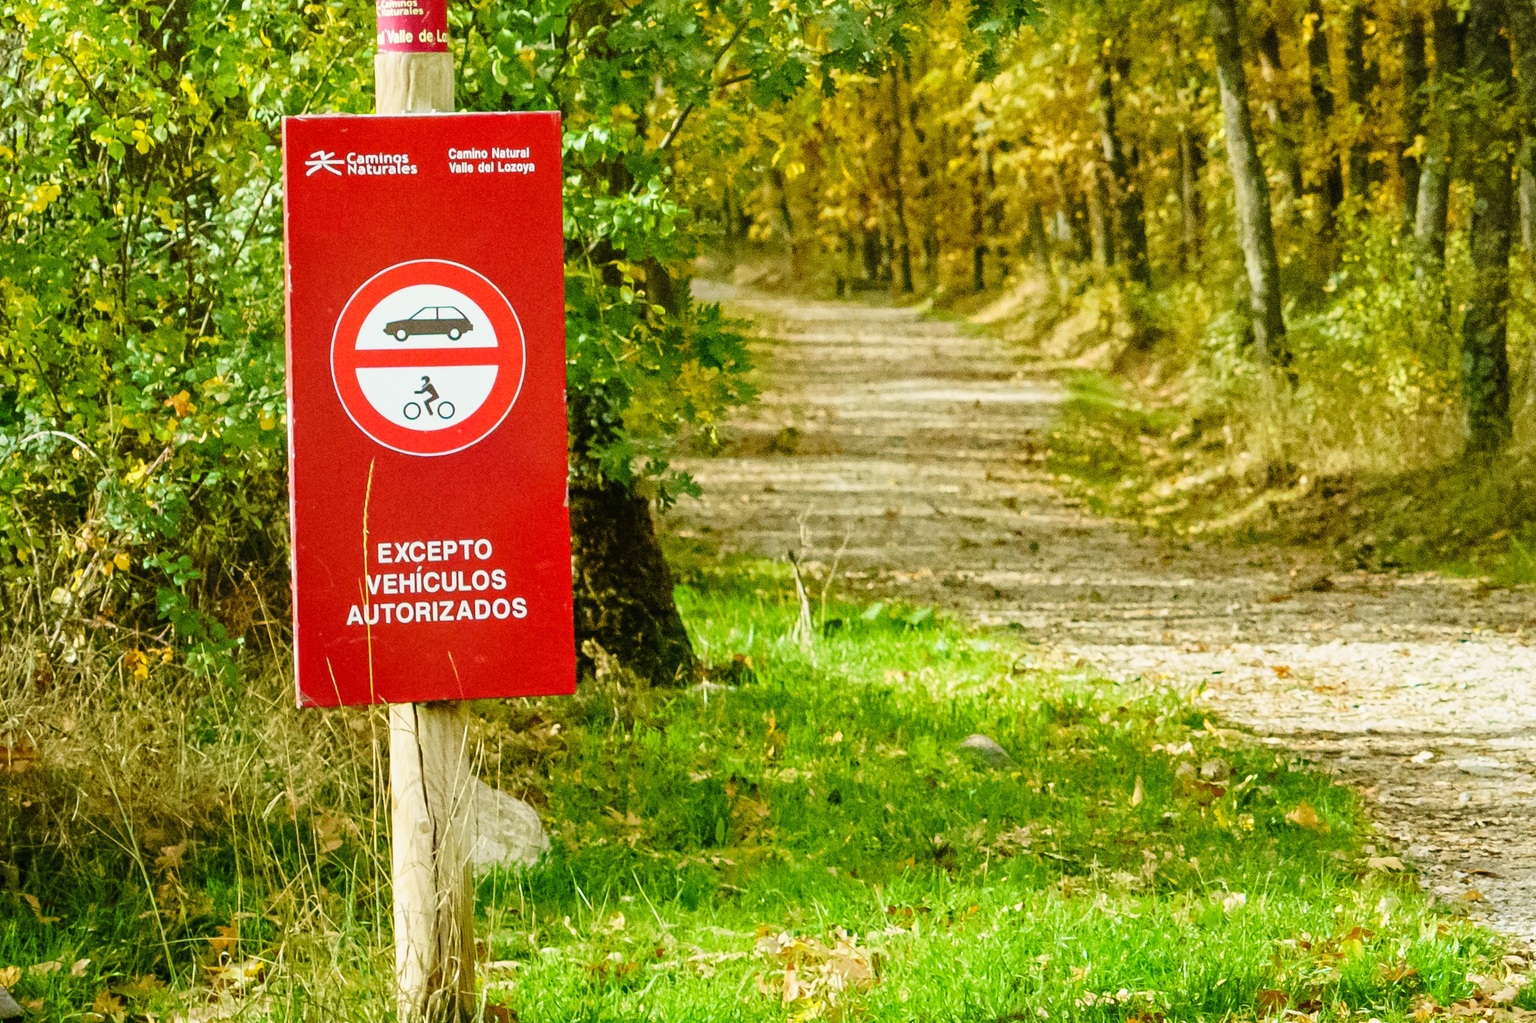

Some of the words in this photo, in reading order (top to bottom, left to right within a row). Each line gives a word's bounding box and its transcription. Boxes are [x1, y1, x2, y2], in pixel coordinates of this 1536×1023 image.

[381, 7, 424, 17] Naturales
[387, 28, 413, 44] Valle
[418, 28, 434, 43] de
[346, 151, 409, 165] Caminos
[448, 147, 489, 160] Camino
[491, 146, 530, 159] Natural
[347, 161, 418, 176] Naturales
[448, 161, 474, 174] Valle
[477, 160, 495, 174] del
[497, 160, 536, 175] Lozoya
[377, 538, 493, 564] EXCEPTO
[366, 565, 507, 595] VEHÍCULOS
[346, 597, 528, 626] AUTORIZADOS
